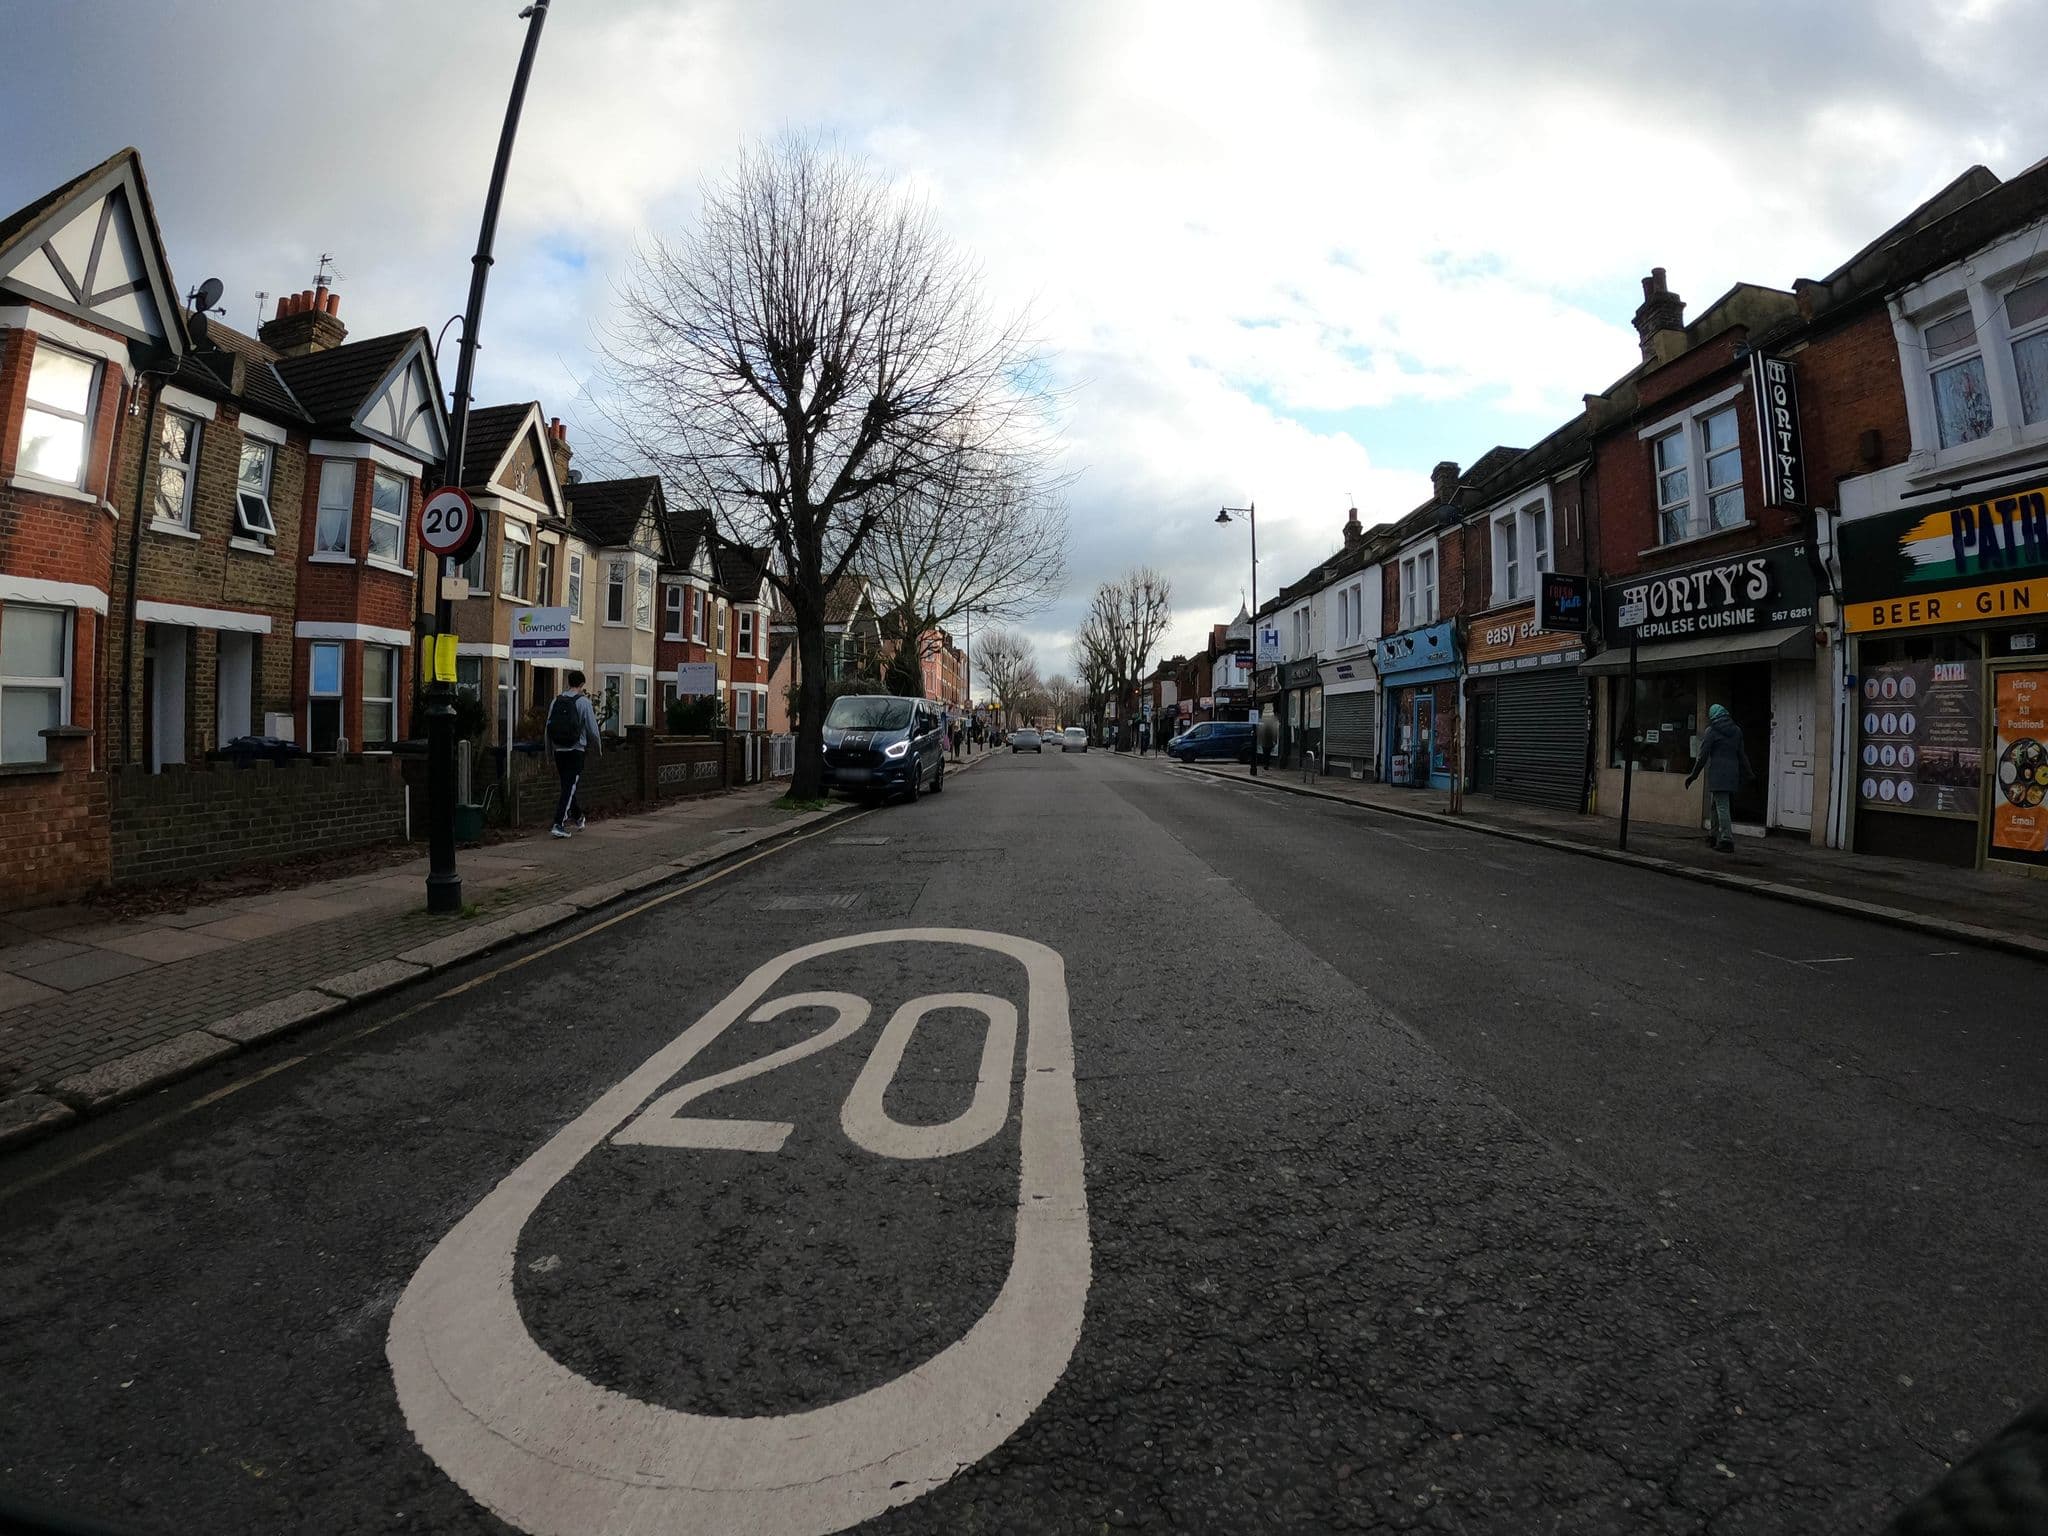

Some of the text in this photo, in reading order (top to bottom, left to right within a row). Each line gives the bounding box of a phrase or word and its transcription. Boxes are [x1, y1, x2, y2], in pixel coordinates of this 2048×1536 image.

[426, 507, 463, 534] 20
[1794, 546, 1805, 557] 54
[1873, 587, 2030, 625] BEER GIN
[1772, 608, 1812, 621] 567 6281
[522, 622, 566, 632] Townends
[1637, 608, 1755, 638] NEPALESE CUISINE
[1486, 624, 1516, 646] easy
[2012, 680, 2037, 690] Hiring
[2017, 693, 2030, 702] For
[2018, 707, 2030, 715] All
[2008, 720, 2044, 729] Positions
[2012, 815, 2035, 826] Email
[611, 991, 1017, 1159] 20
